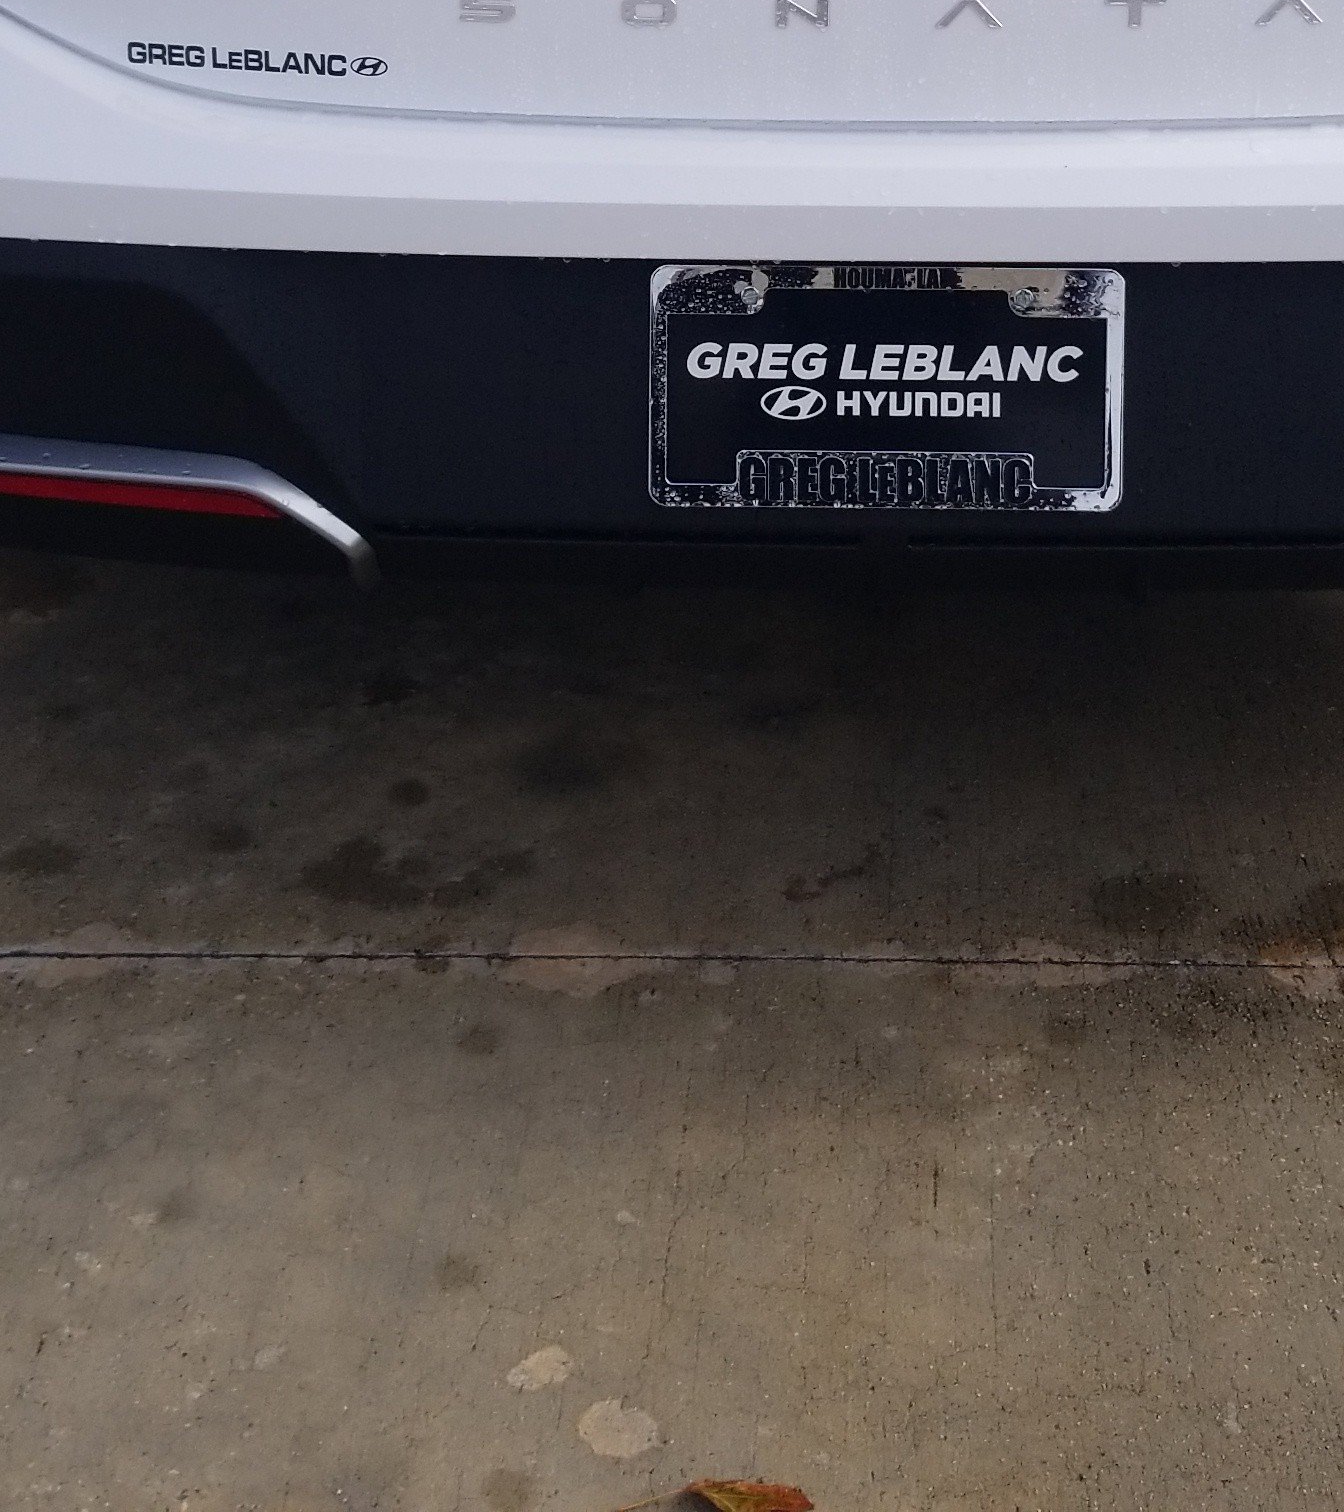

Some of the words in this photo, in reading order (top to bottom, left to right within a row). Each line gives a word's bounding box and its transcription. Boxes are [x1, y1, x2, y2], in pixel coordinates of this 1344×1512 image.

[127, 41, 206, 68] GREG
[686, 342, 827, 380] GREG
[838, 344, 1084, 383] LEBLANC
[837, 390, 1001, 418] HYUNDAI
[738, 456, 847, 503] GREG
